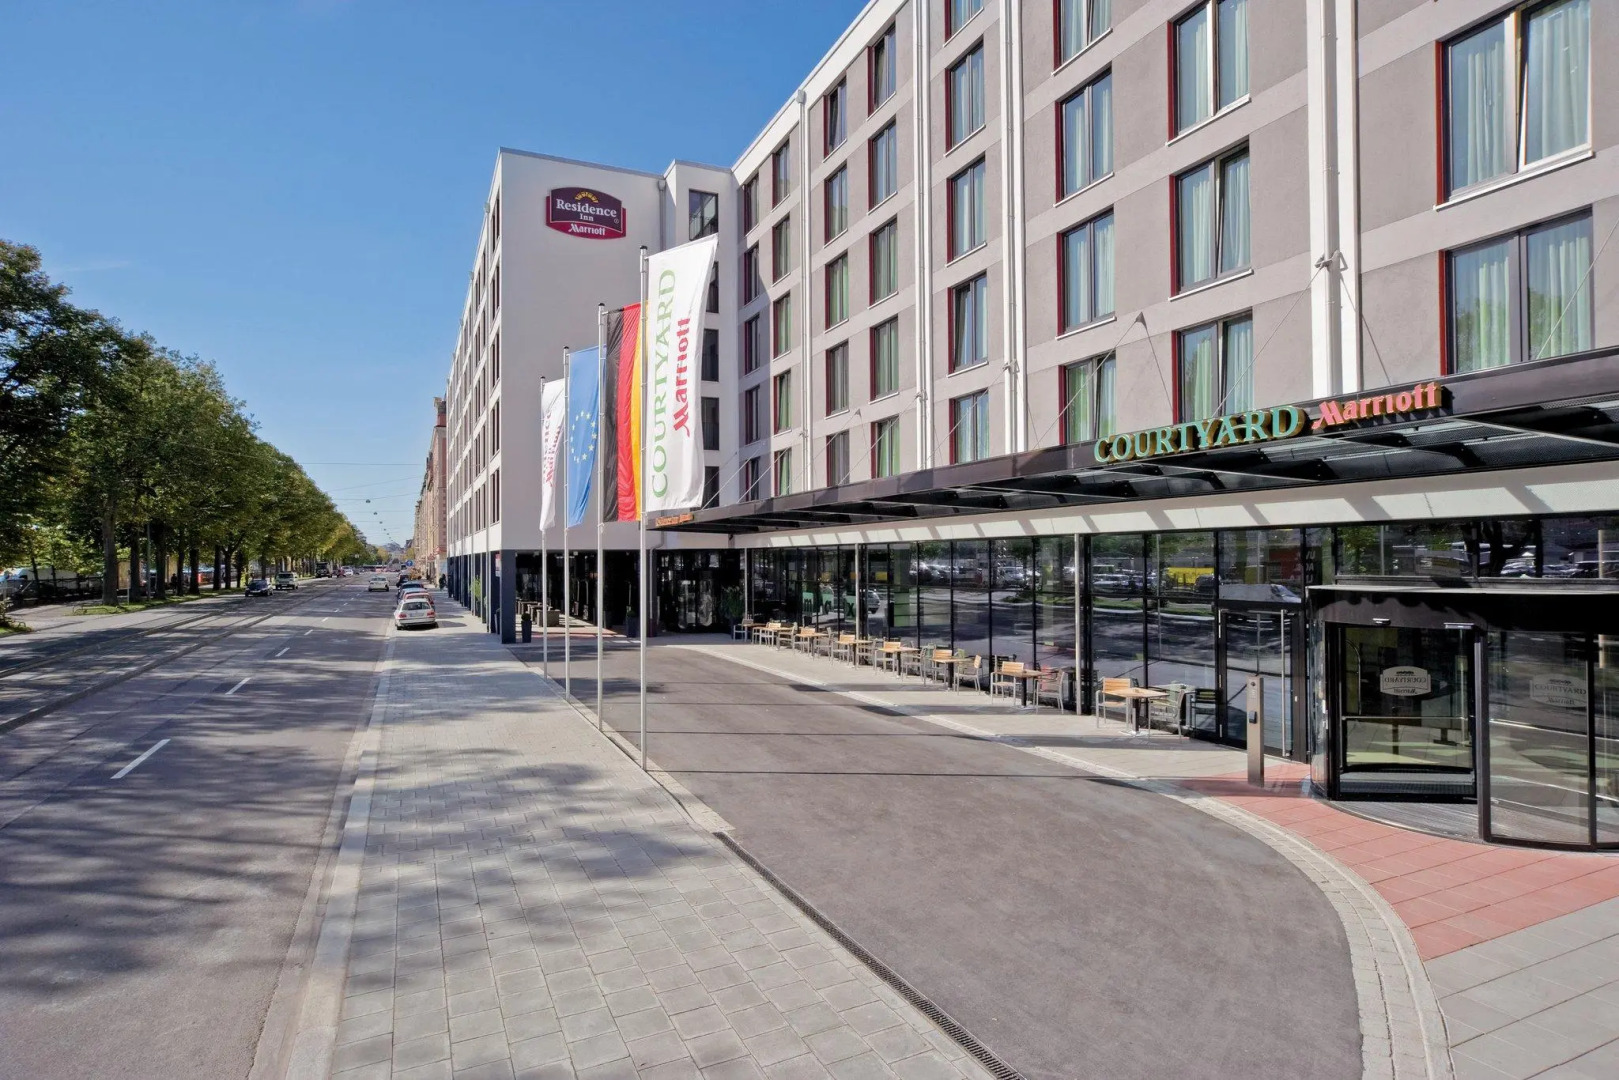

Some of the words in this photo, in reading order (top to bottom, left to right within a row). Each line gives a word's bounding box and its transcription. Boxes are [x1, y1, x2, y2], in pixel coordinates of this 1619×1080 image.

[556, 198, 617, 218] Residence
[568, 223, 606, 236] Marriott
[580, 213, 594, 222] Inn
[651, 269, 676, 498] COURTYARD
[673, 317, 691, 438] Marriott
[1093, 405, 1305, 463] COURTYARD
[1311, 381, 1442, 430] Marriott
